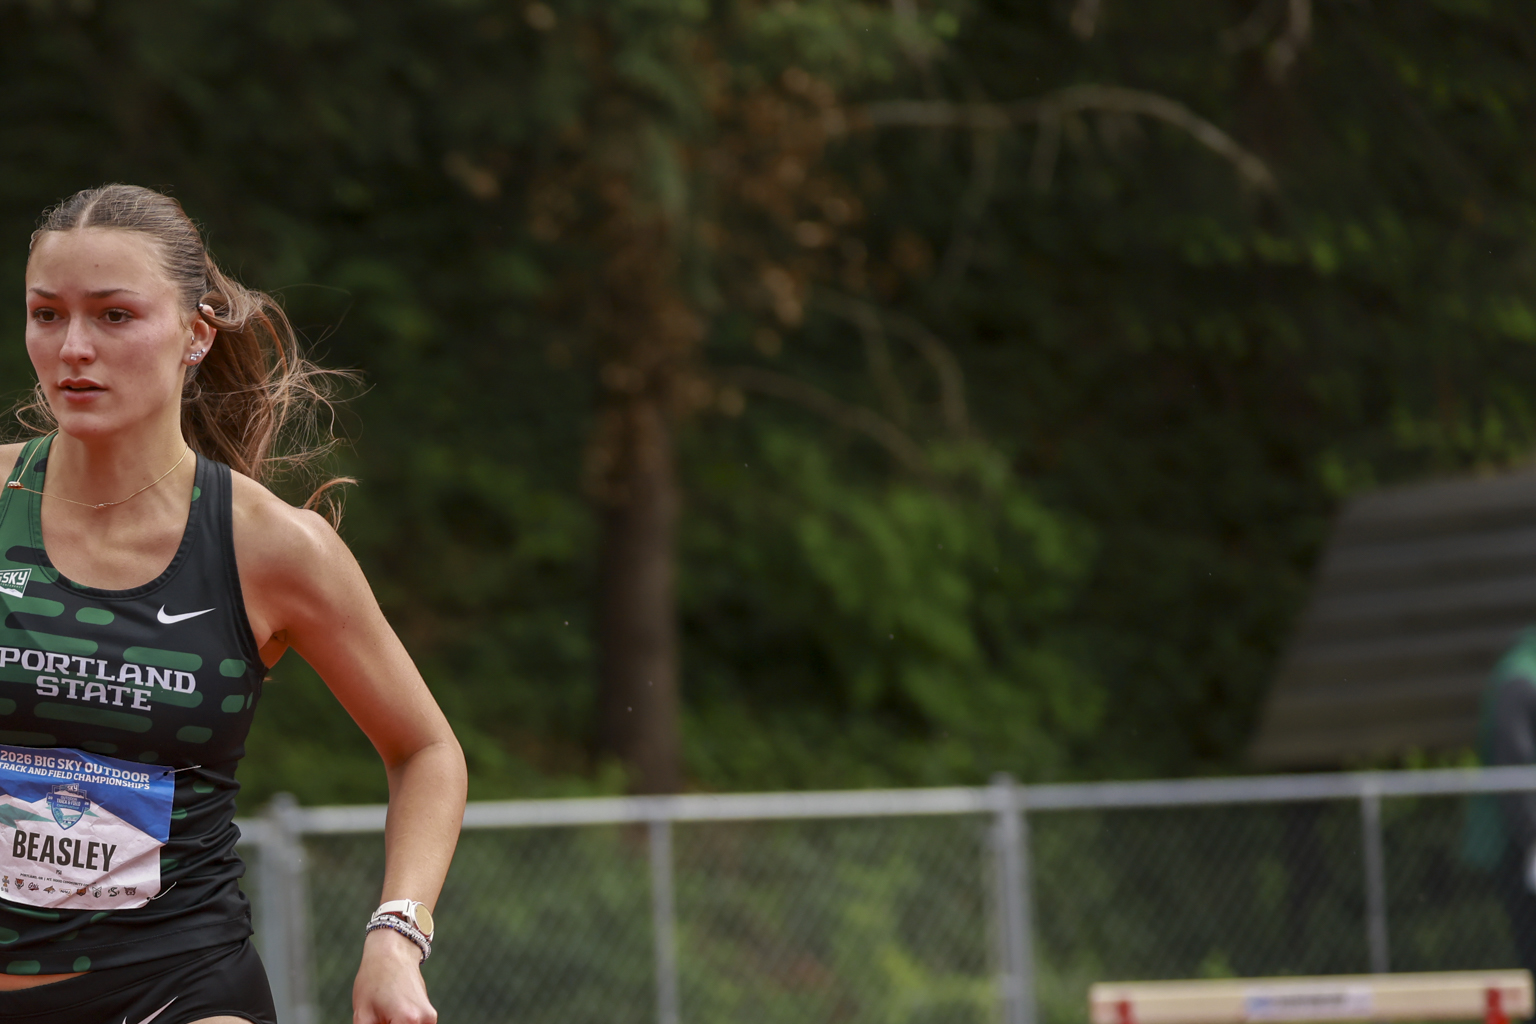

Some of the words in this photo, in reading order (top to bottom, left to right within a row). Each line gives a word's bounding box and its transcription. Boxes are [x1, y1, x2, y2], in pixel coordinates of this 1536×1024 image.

[35, 674, 152, 711] STATE
[0, 750, 32, 765] 2026
[34, 755, 55, 768] BIG
[57, 758, 82, 772] SKY
[84, 762, 150, 783] OUTDOOR
[29, 766, 48, 776] AND
[48, 770, 73, 780] FIELD
[73, 772, 150, 790] CHAMPIONSHIPS
[12, 829, 117, 872] BEASLEY
